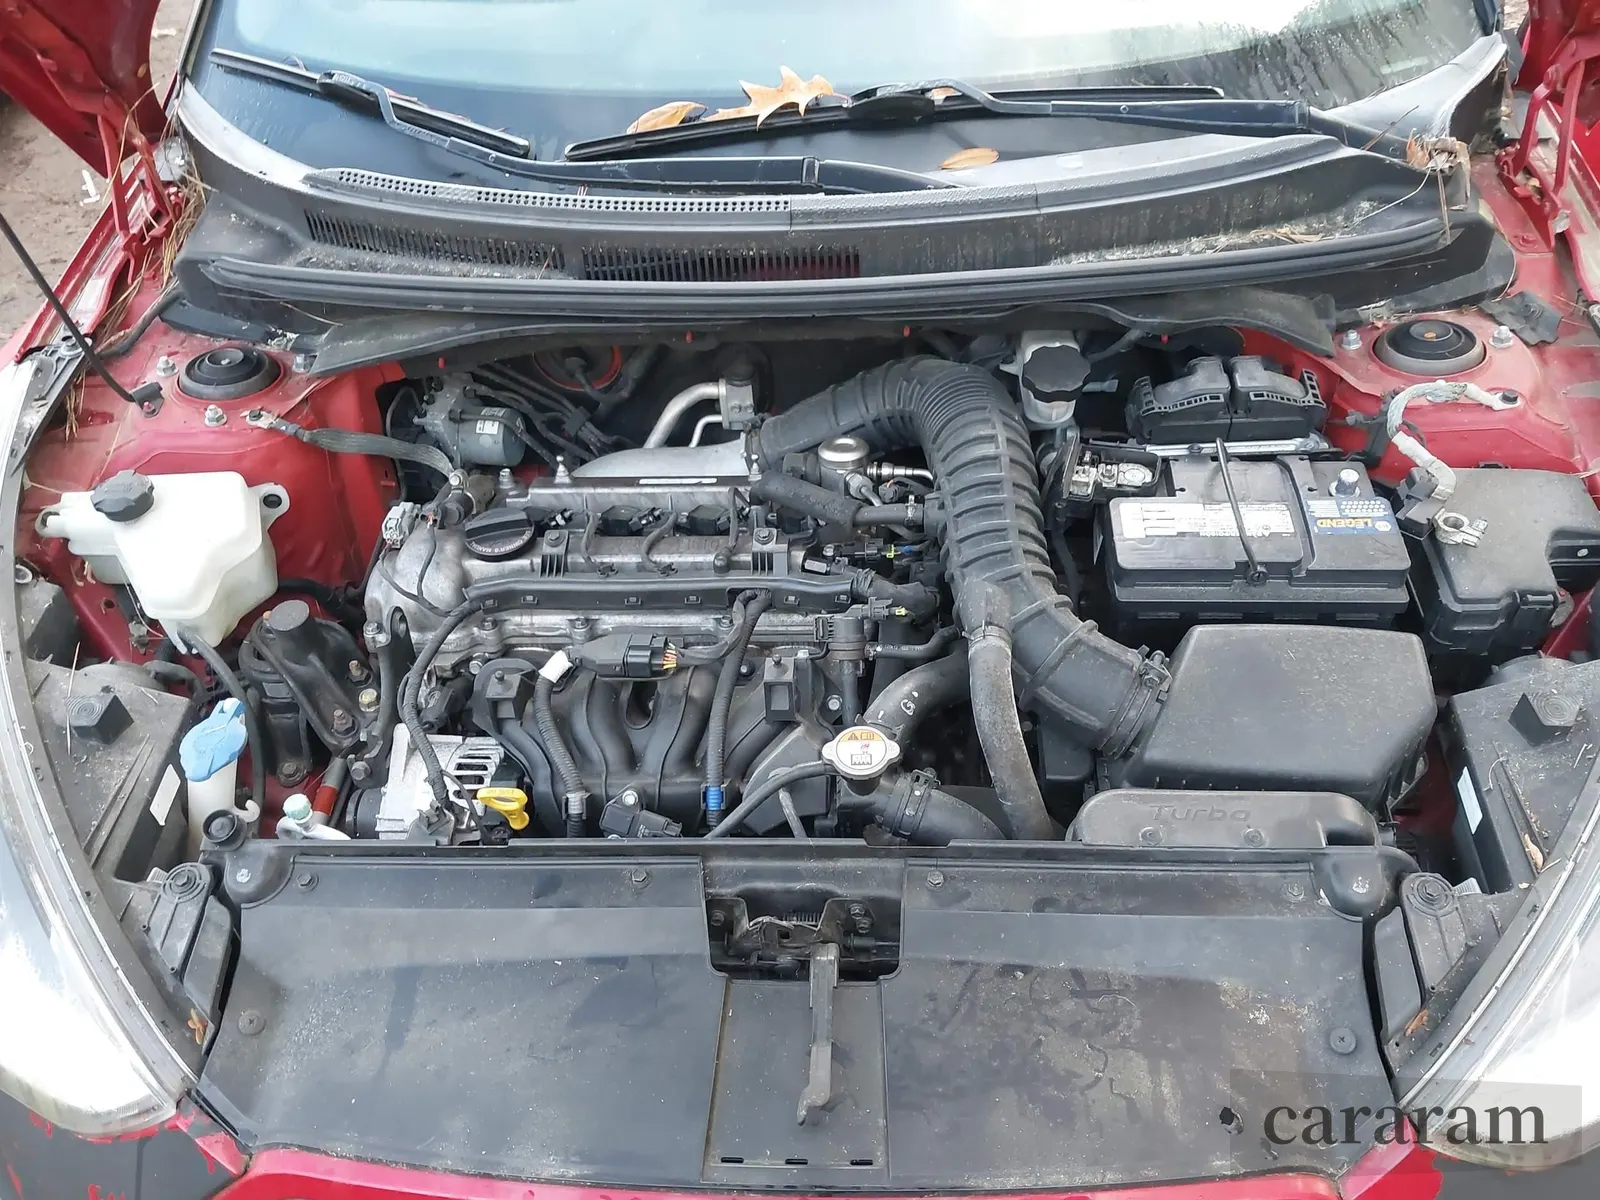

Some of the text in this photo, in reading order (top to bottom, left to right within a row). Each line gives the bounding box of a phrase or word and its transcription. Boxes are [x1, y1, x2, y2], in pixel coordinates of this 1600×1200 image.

[1316, 518, 1374, 529] LEGEND
[469, 541, 493, 553] MANUAL
[1149, 804, 1251, 822] Turbo
